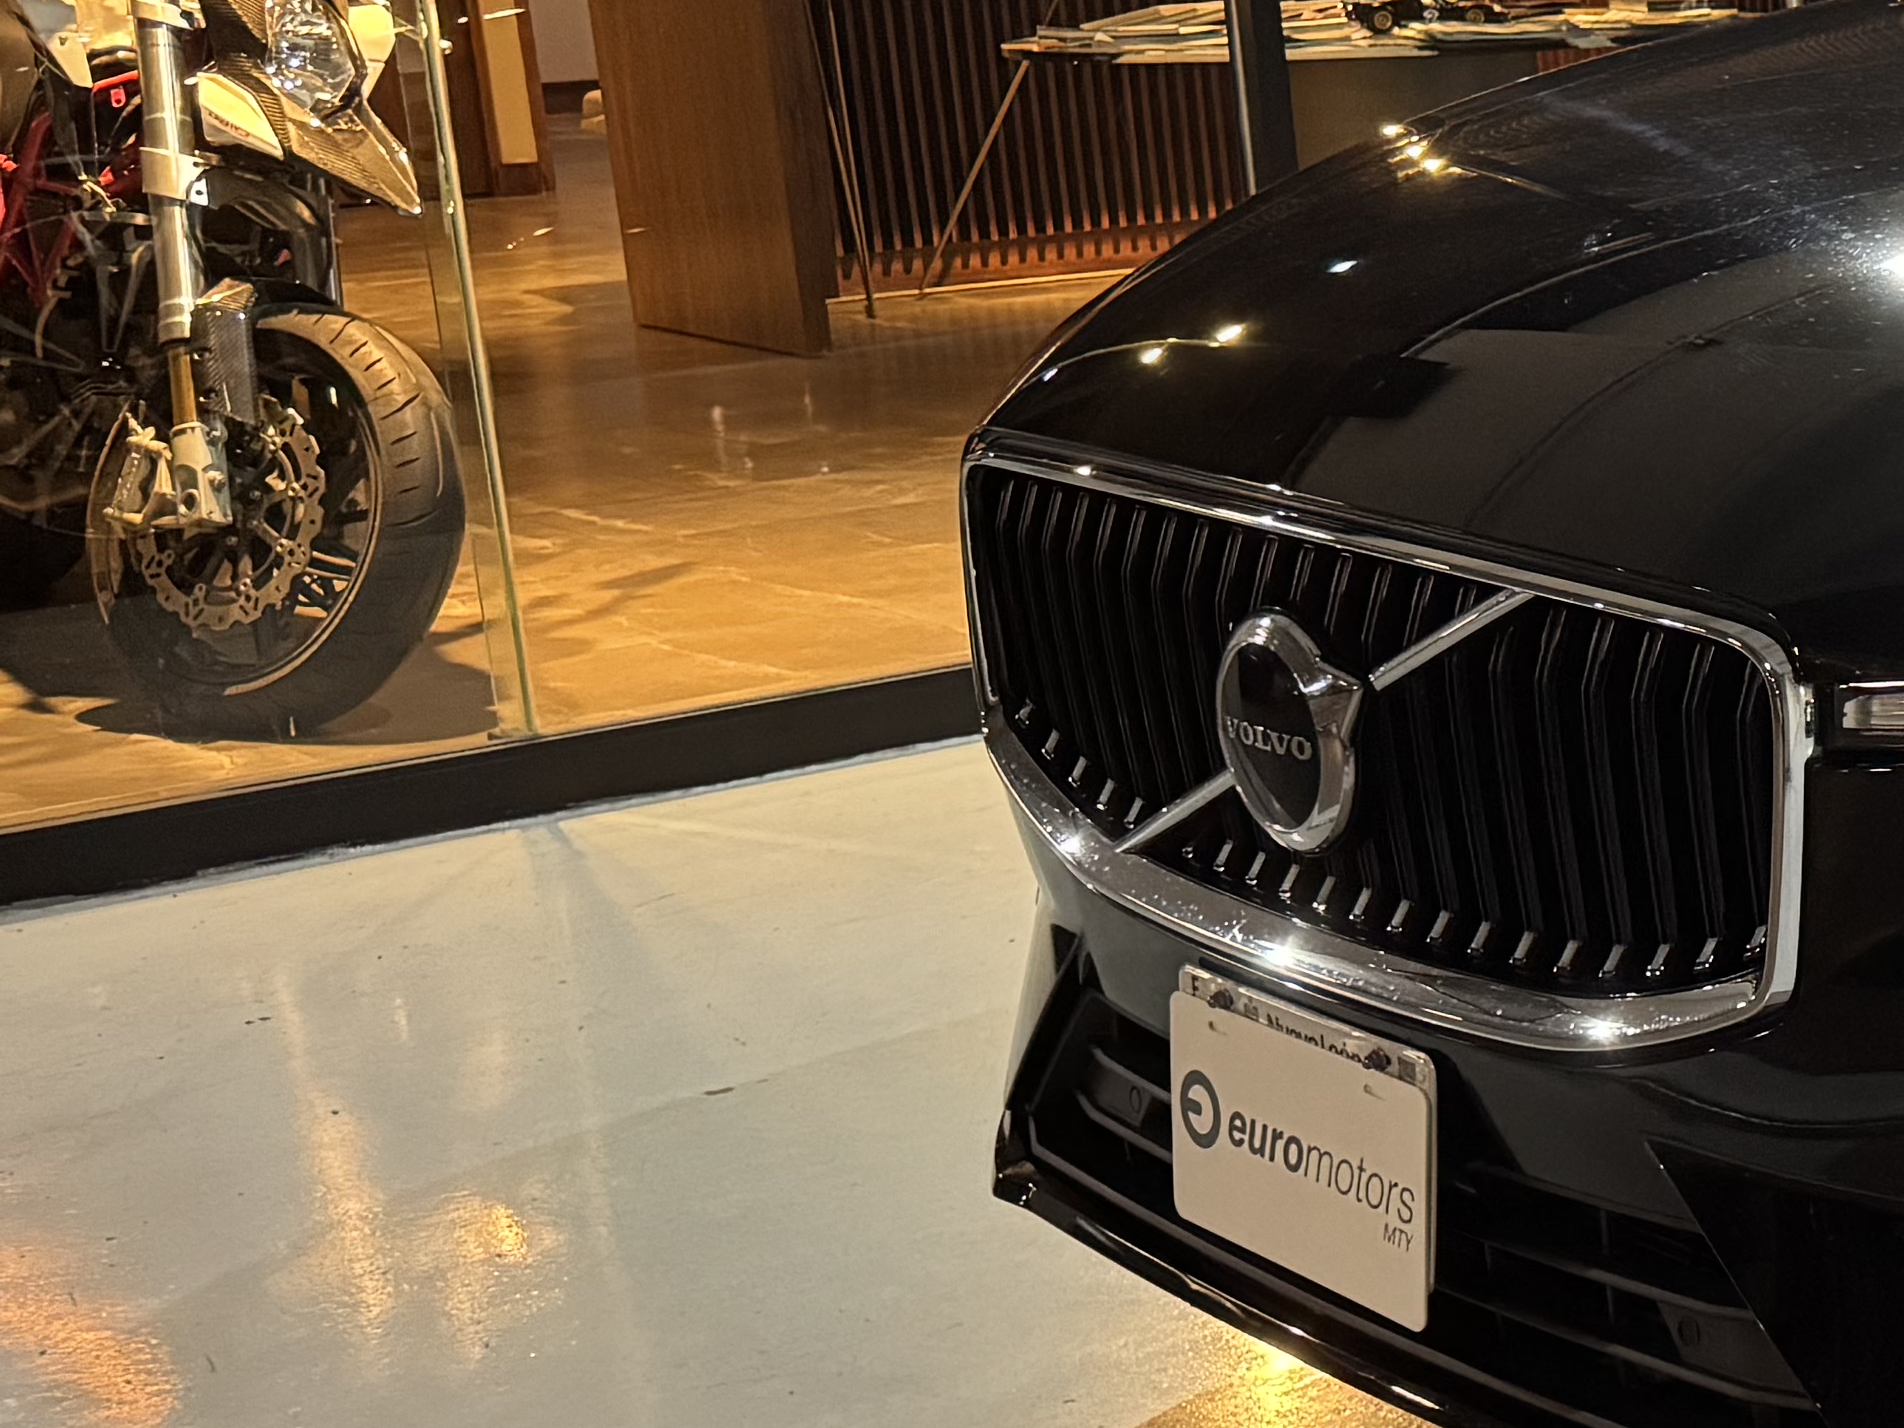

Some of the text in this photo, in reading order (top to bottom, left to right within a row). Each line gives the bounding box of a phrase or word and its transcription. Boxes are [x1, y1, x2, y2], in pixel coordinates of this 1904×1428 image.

[1225, 715, 1313, 761] VOLVO
[1227, 1109, 1416, 1225] euromotors
[1382, 1221, 1414, 1253] MTY
